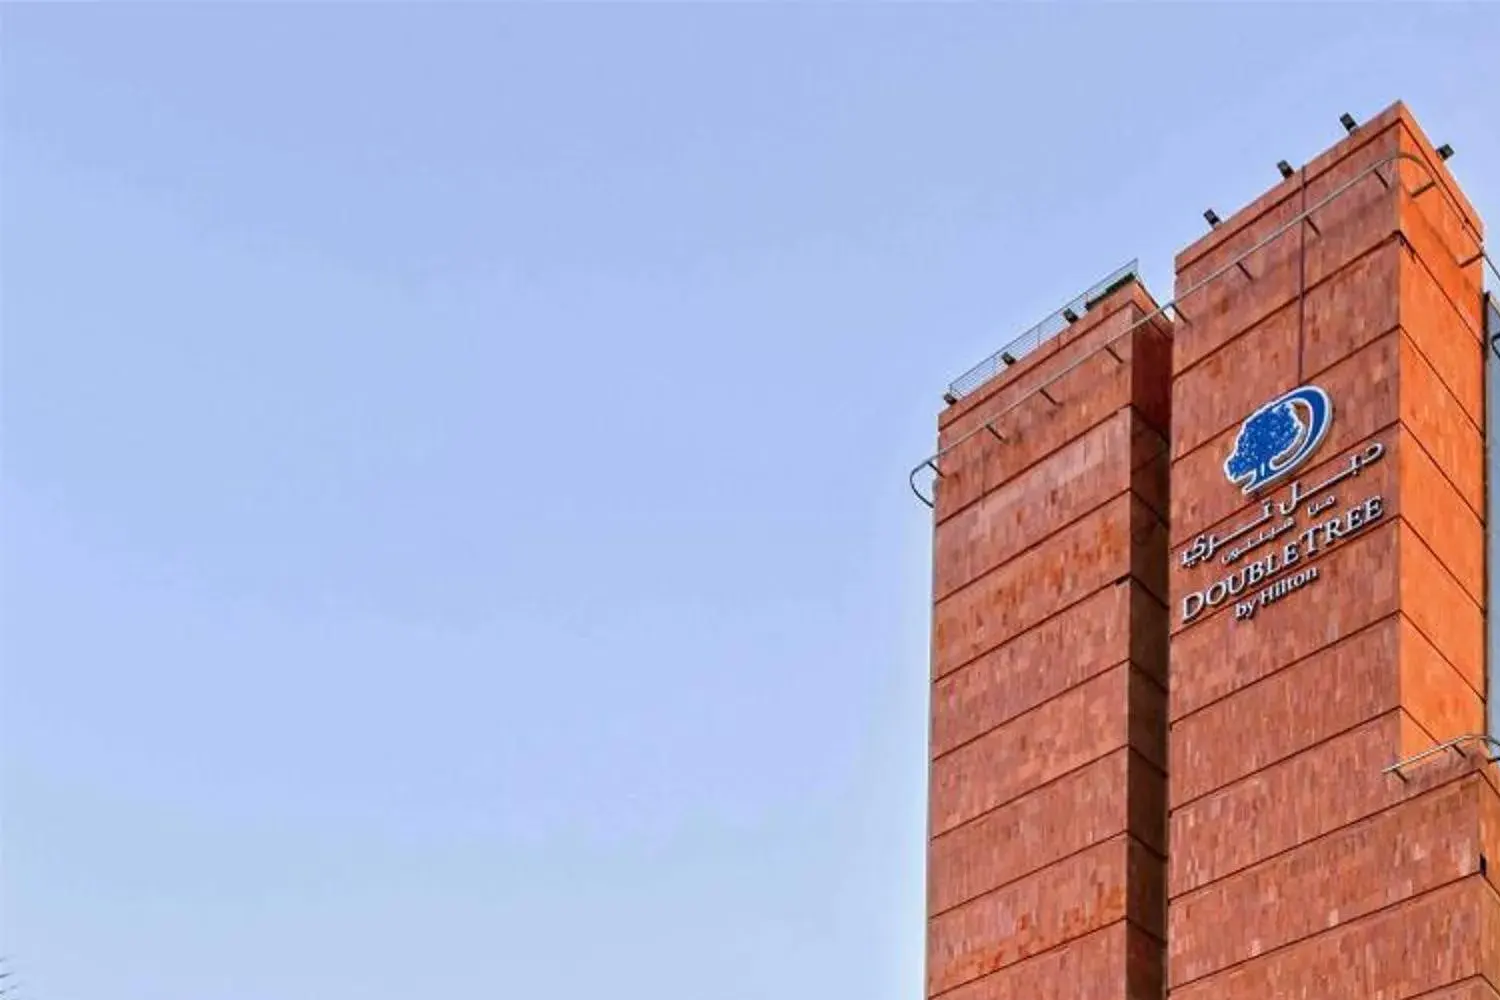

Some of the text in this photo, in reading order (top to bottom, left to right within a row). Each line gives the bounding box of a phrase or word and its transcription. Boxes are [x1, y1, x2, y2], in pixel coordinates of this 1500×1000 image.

[1182, 494, 1384, 620] DOUBLETREE
[1235, 566, 1318, 619] by Hilton
